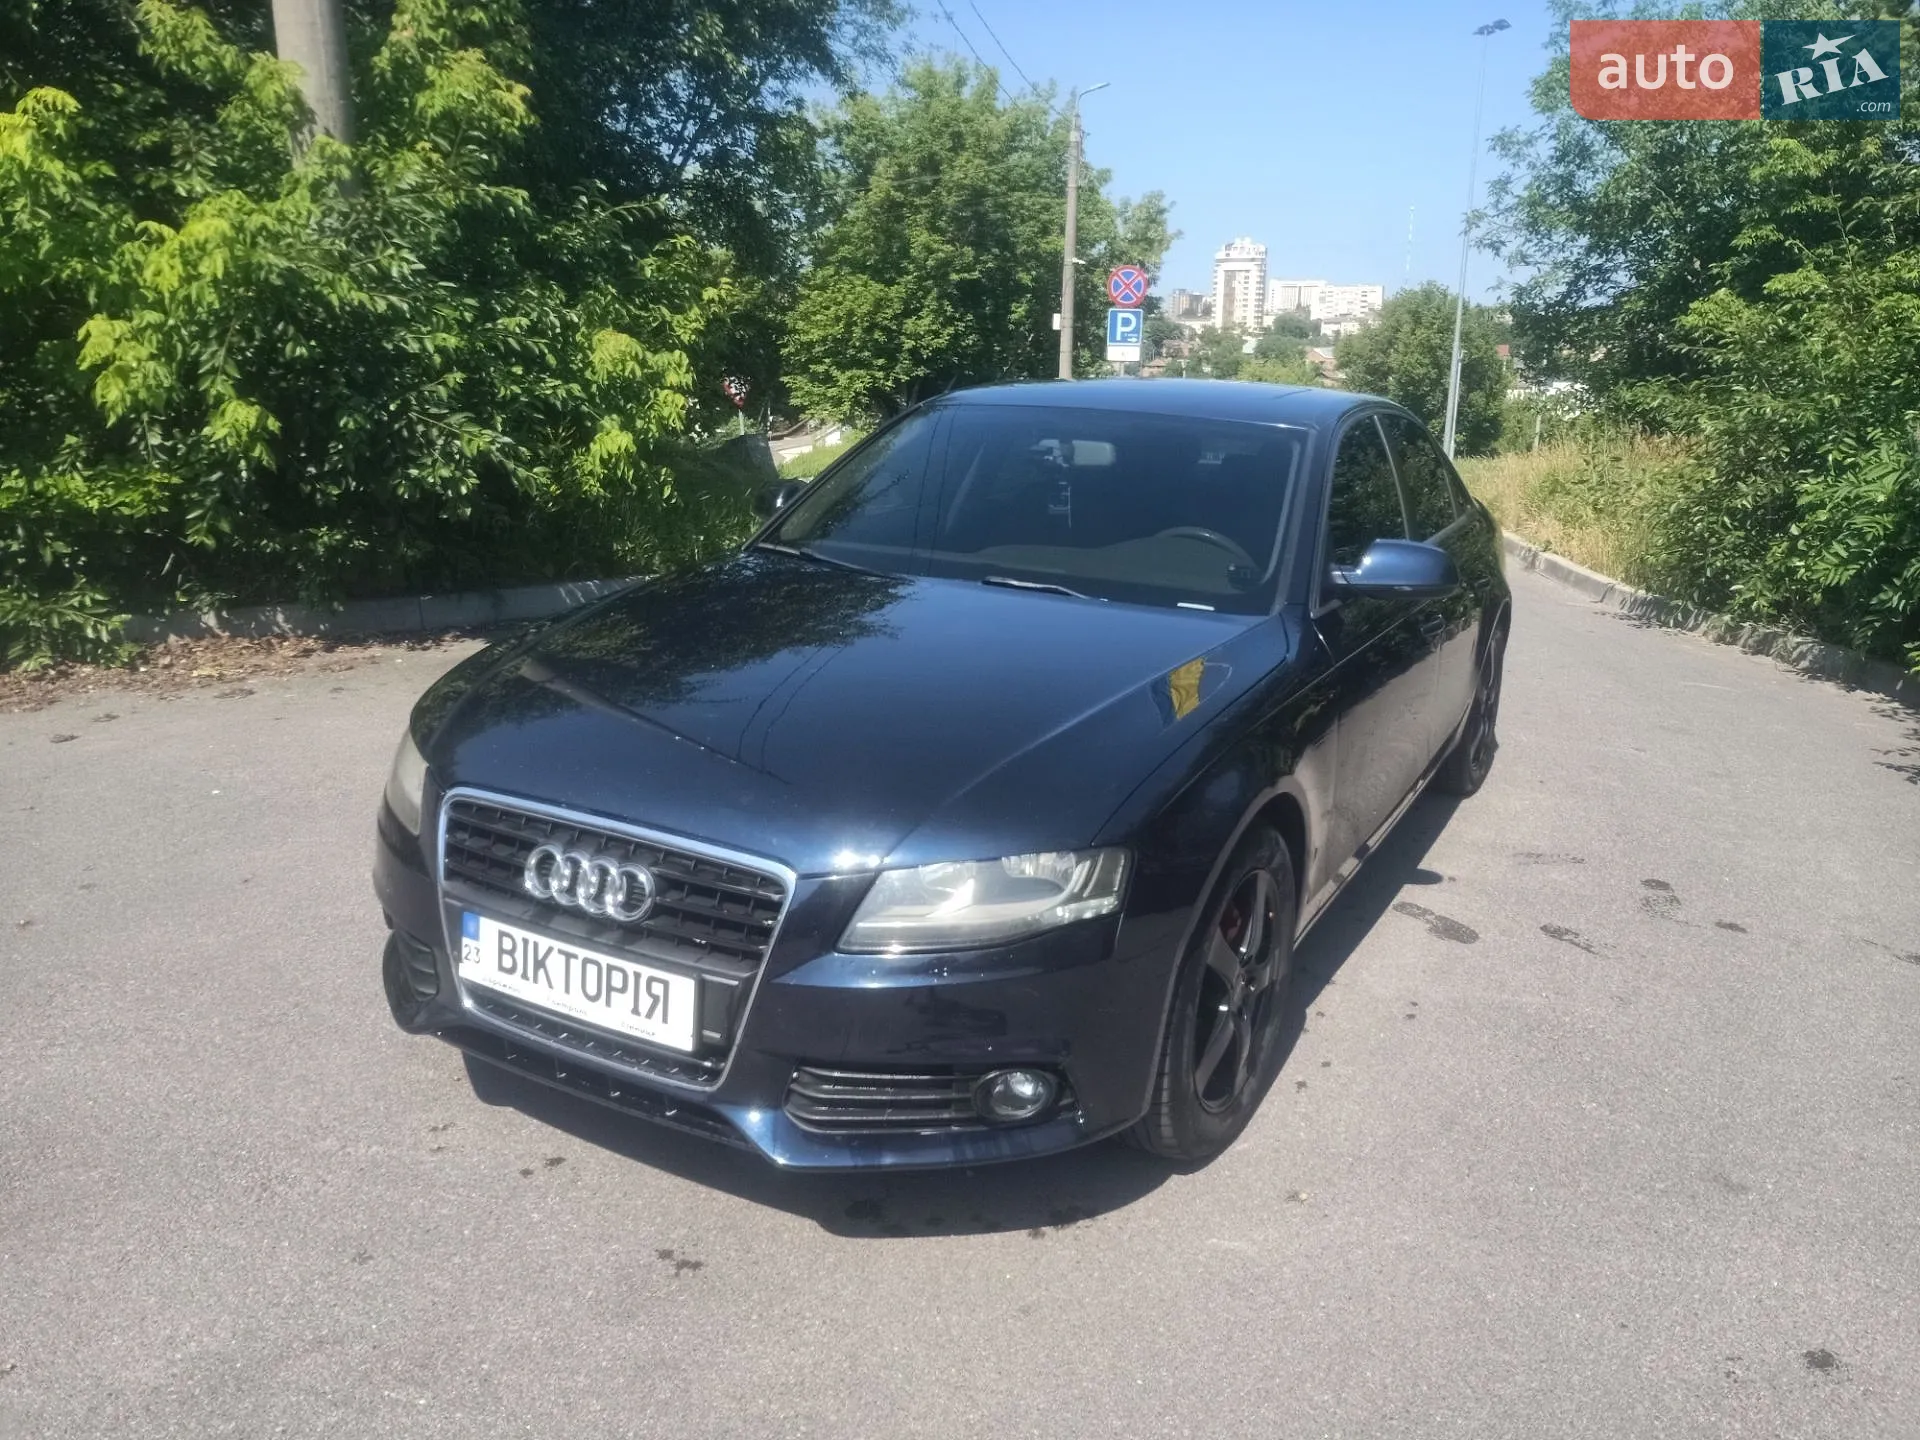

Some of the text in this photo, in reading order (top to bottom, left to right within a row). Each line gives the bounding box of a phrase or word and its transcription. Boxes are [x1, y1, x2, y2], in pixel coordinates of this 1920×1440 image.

[1116, 312, 1137, 341] P
[463, 943, 481, 964] 23
[497, 928, 670, 1024] ВІКТОРІЯ
